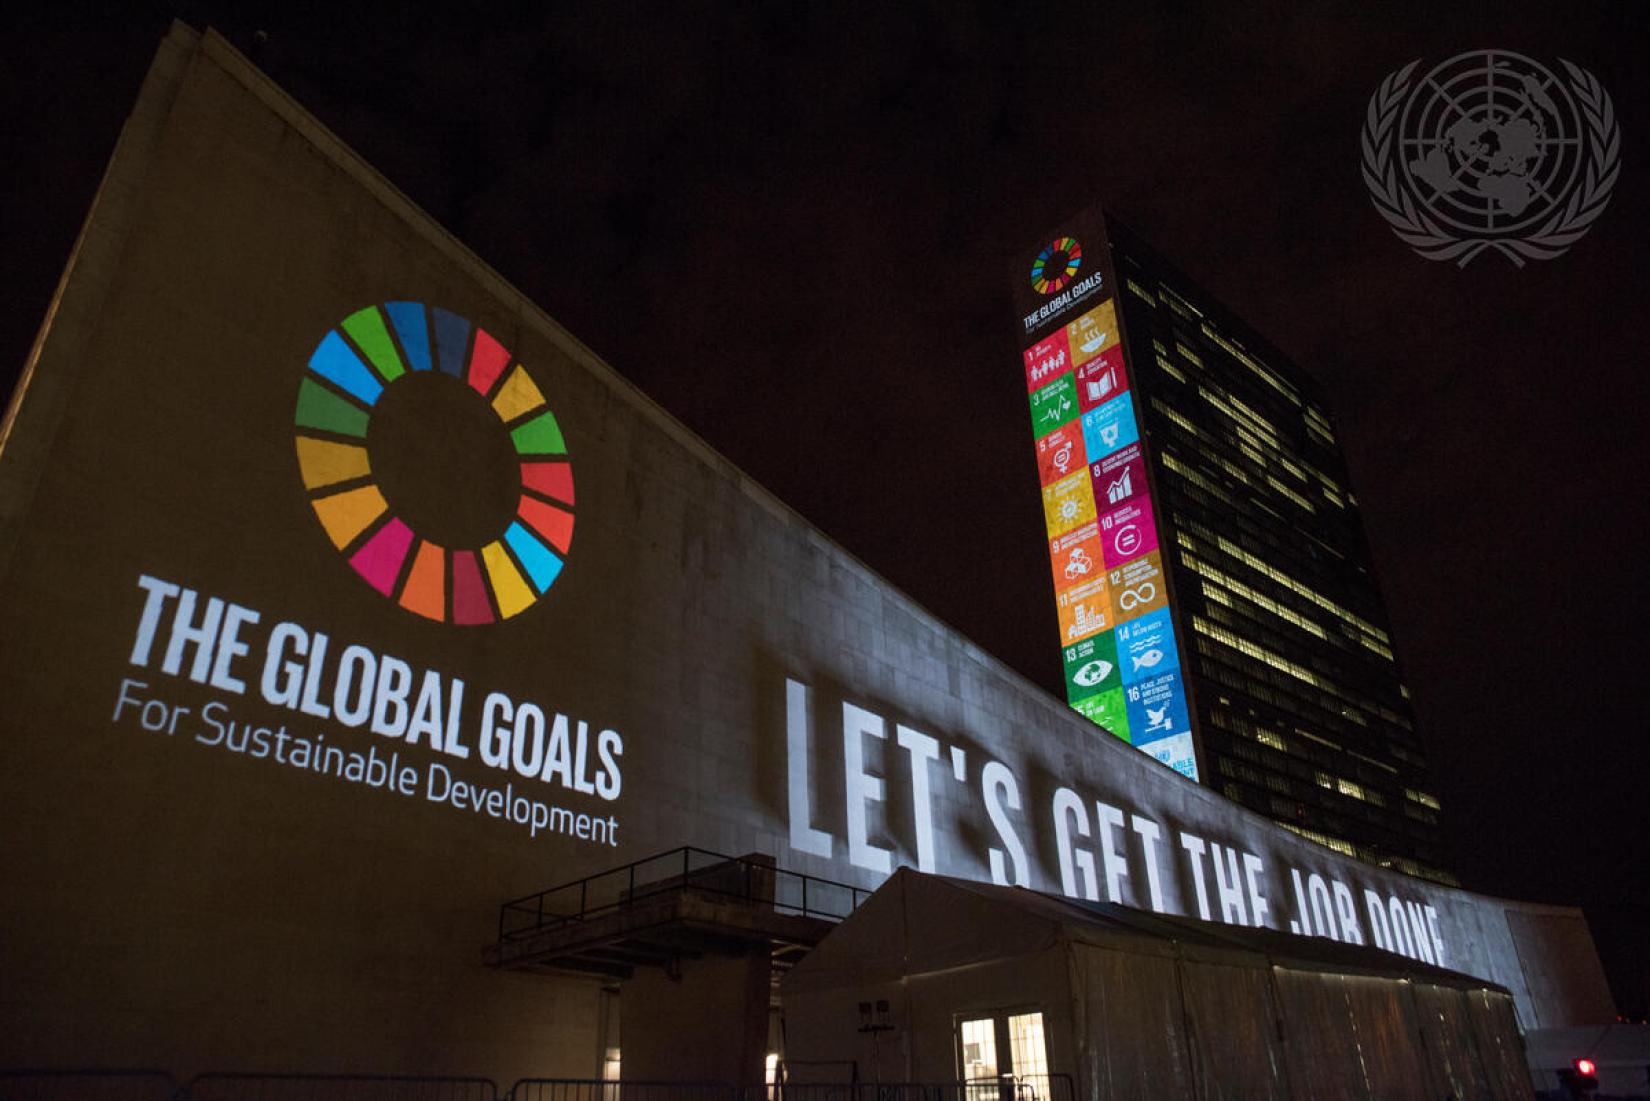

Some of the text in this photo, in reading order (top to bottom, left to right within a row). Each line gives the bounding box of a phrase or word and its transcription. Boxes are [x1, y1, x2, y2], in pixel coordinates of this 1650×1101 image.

[1024, 310, 1041, 329] THE
[1040, 291, 1072, 318] GLOBAL
[1072, 272, 1102, 298] GOALS
[1093, 464, 1101, 478] 8
[1102, 516, 1113, 531] 10
[1052, 540, 1060, 554] 9
[1110, 570, 1121, 586] 12
[1059, 593, 1068, 608] 11
[1118, 625, 1129, 641] 14
[1066, 648, 1077, 662] 13
[129, 574, 624, 801] THE GLOBAL GOALS
[1127, 686, 1140, 702] 16
[112, 677, 620, 847] For Sustainable Development
[786, 678, 1446, 969] LET'S GET THE JOB DONE
